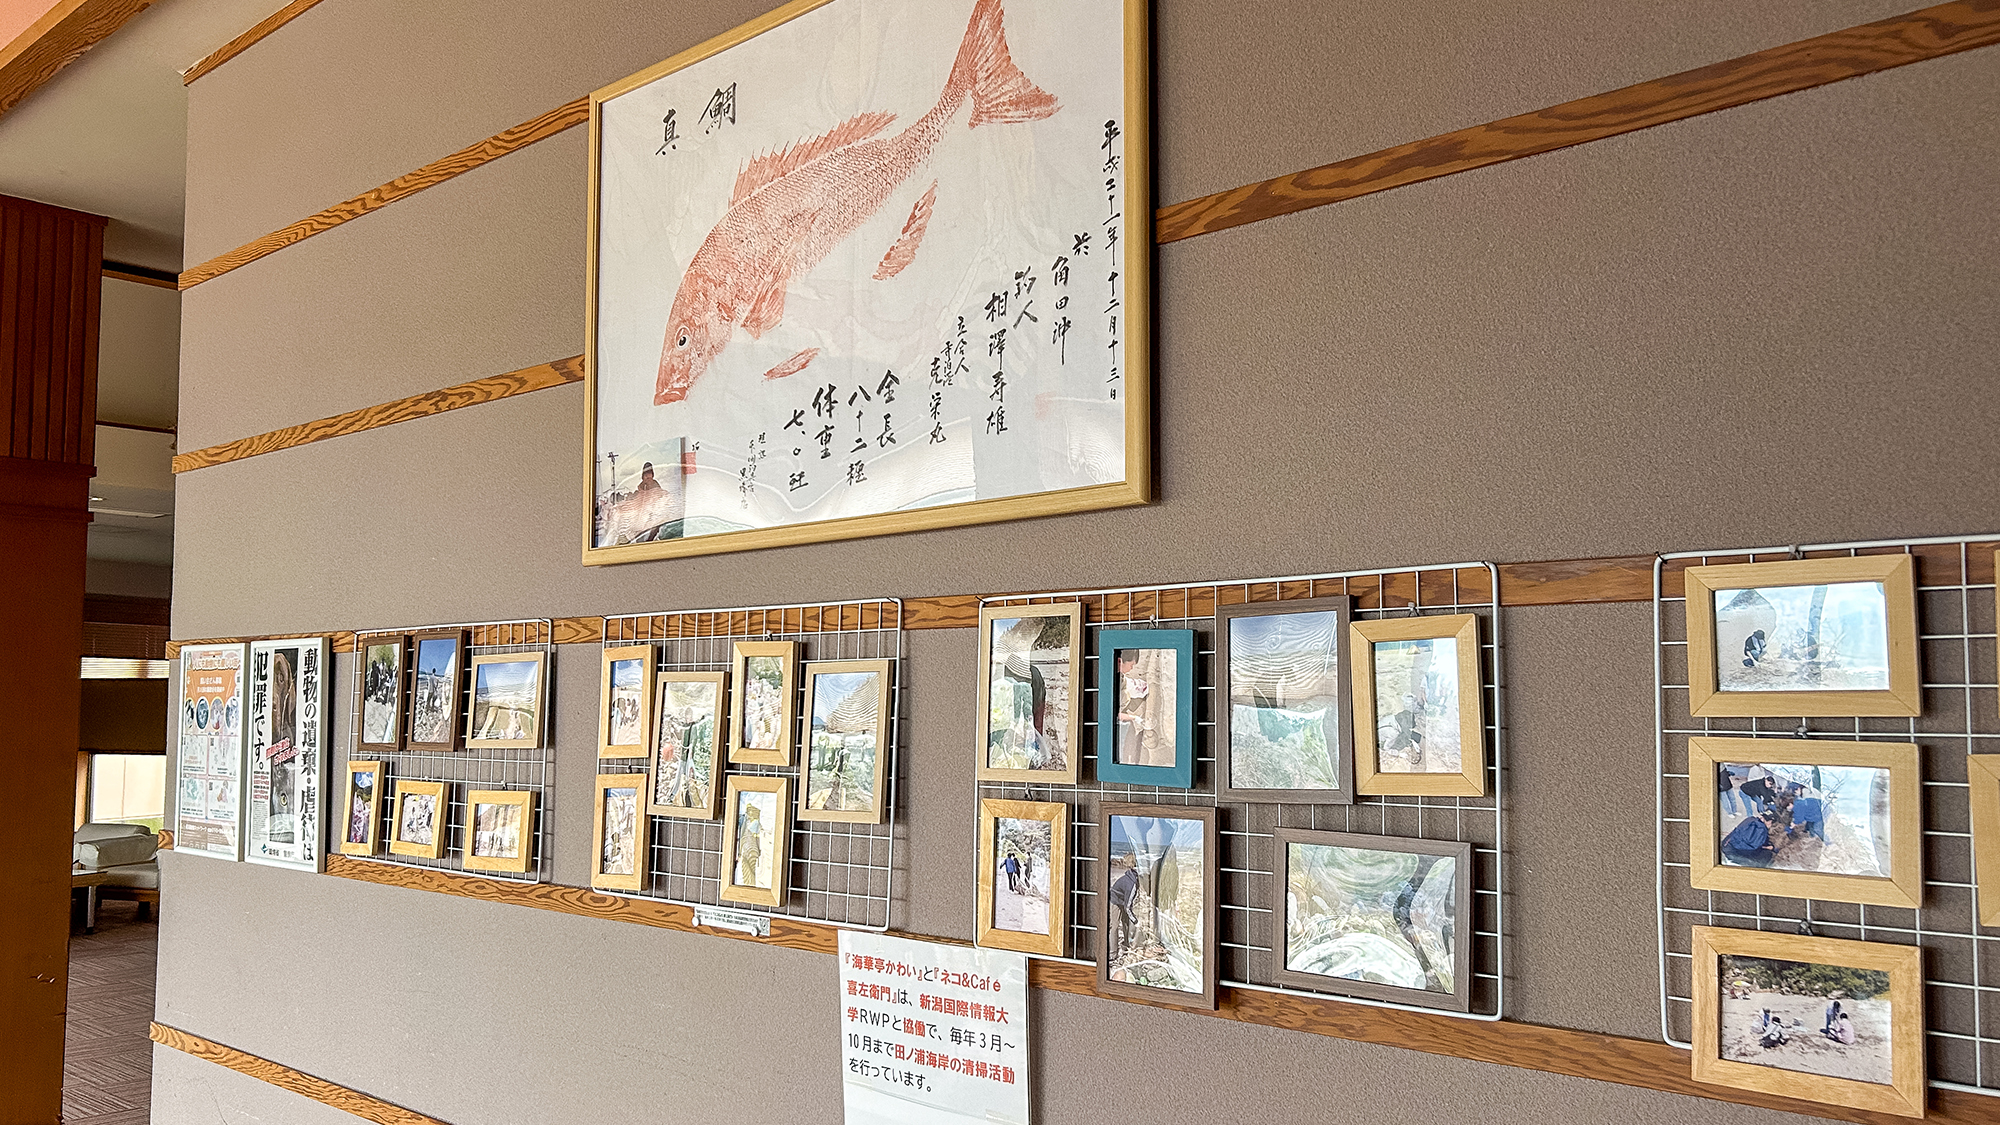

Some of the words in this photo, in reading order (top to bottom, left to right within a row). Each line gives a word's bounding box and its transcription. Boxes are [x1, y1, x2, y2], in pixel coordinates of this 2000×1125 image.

[811, 383, 839, 460] 体重
[253, 650, 269, 770] 犯罪です。
[300, 647, 319, 862] 動物の遺棄・虐待は
[847, 980, 1009, 1025] 喜左衛門』は、新潟国際情報大
[848, 1033, 1015, 1085] 10月まで田ノ浦海岸の清掃活動
[849, 1057, 932, 1092] を行っています。
